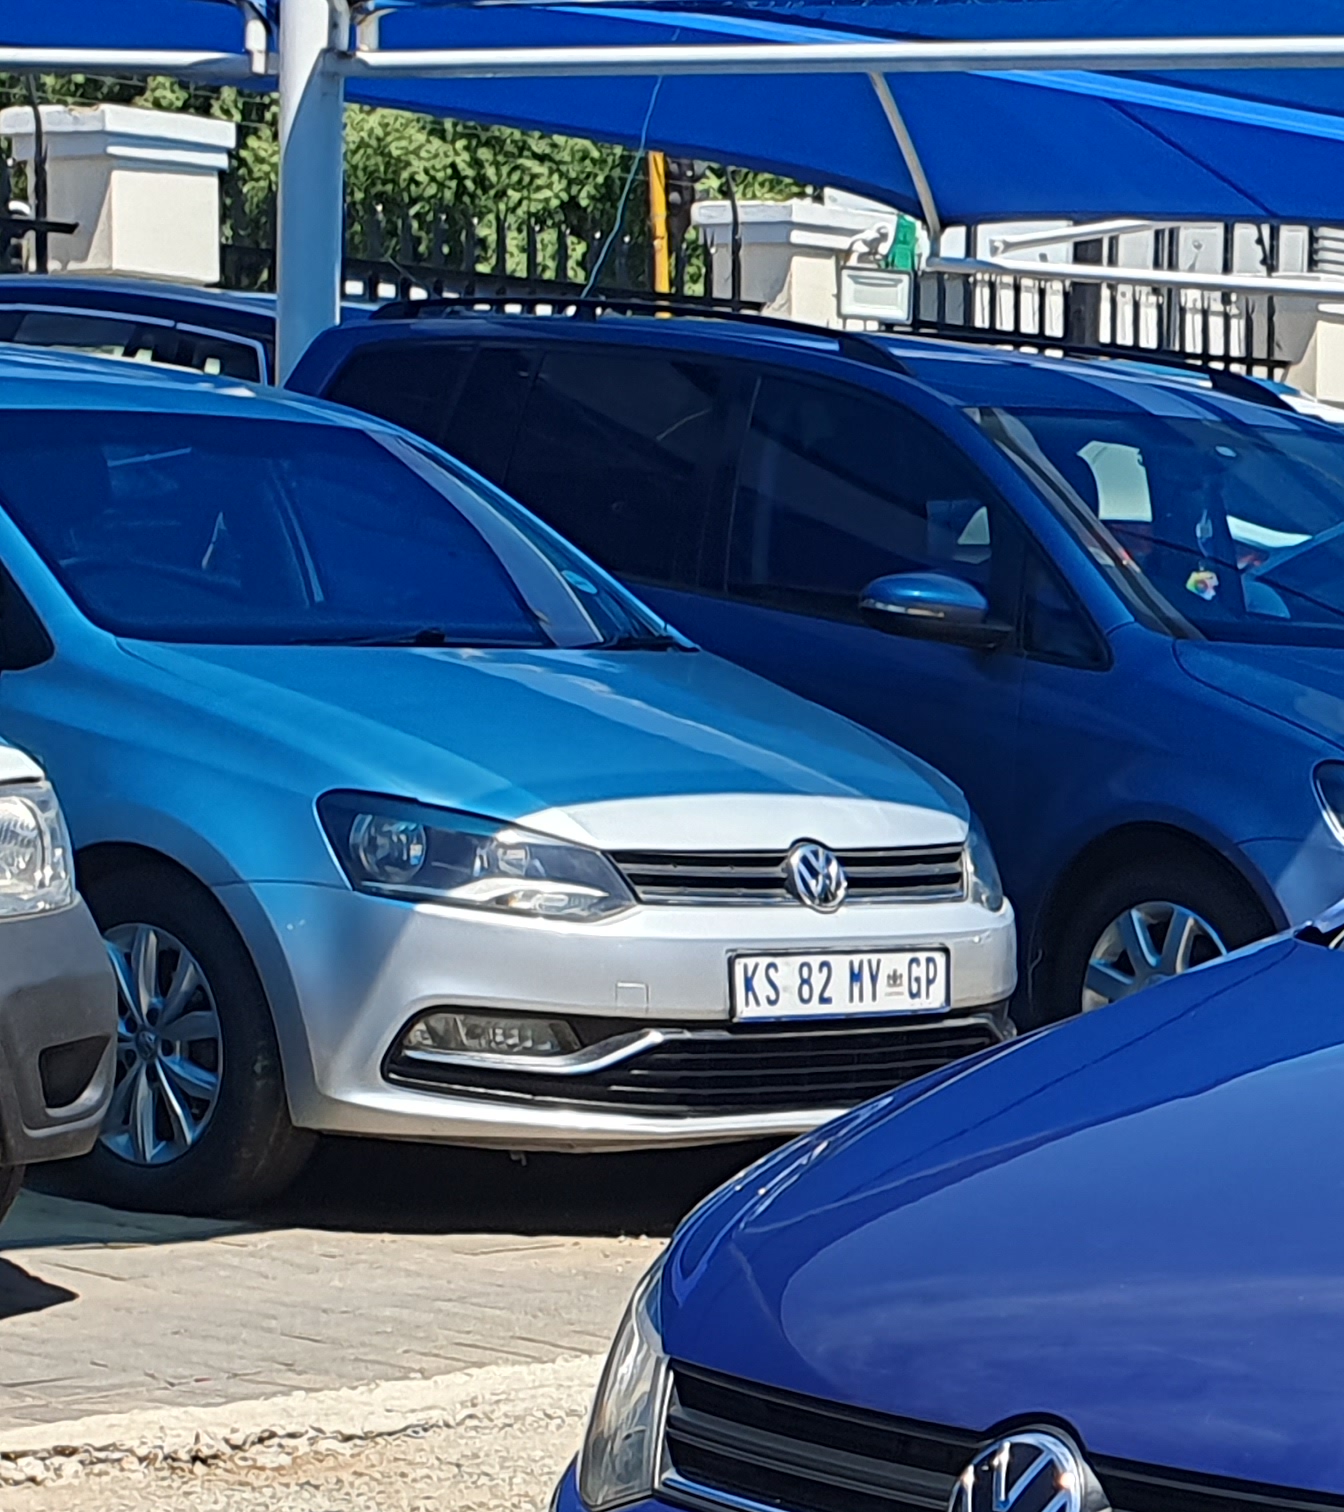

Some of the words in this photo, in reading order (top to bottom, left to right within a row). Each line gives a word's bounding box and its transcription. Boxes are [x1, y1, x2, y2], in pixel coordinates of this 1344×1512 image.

[743, 961, 781, 1007] KS
[798, 960, 833, 1005] 82
[849, 957, 882, 1004] MY
[908, 956, 938, 1000] GP
